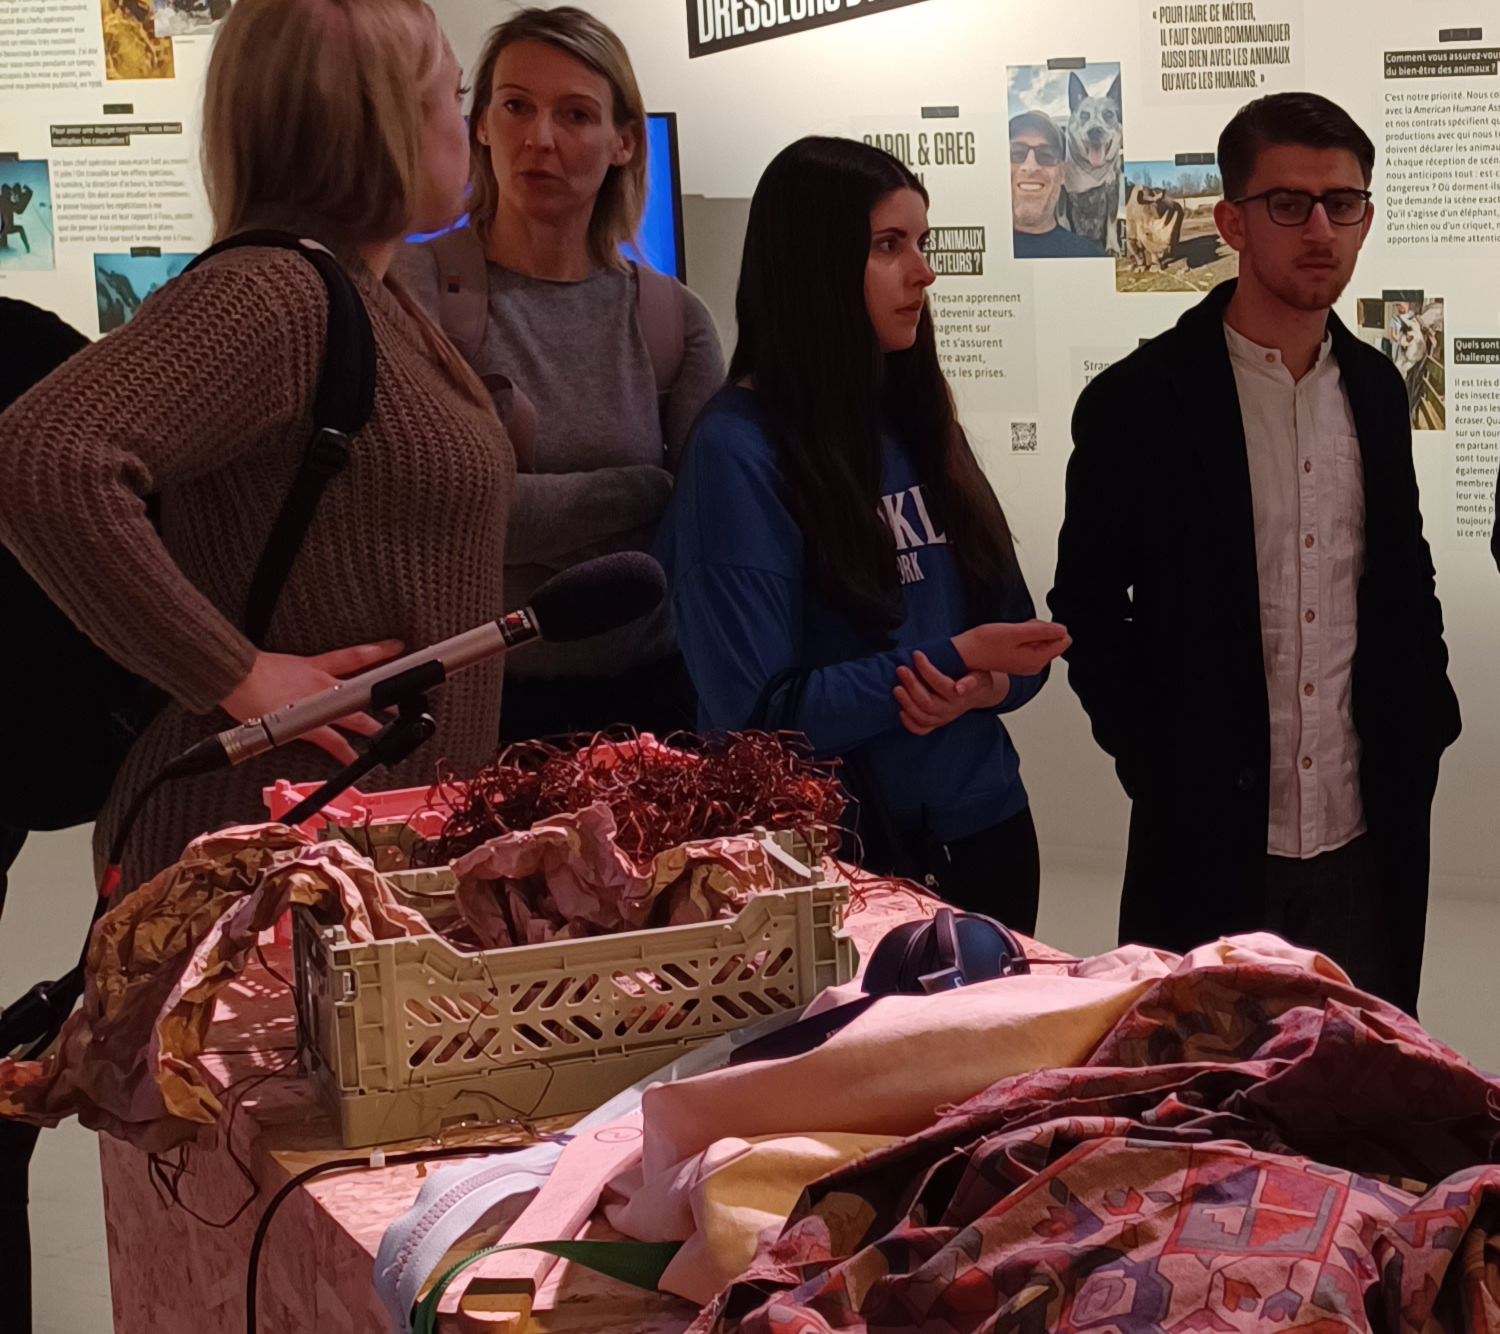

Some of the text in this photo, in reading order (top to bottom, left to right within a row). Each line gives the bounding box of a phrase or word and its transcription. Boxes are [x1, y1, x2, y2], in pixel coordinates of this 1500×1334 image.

[1159, 5, 1183, 24] POUR
[1184, 4, 1207, 23] FAIRE
[1221, 1, 1256, 22] MÉTIER,
[1168, 27, 1189, 46] FAUT
[1191, 26, 1223, 45] SAVOIR
[1224, 24, 1290, 44] COMMUNIQUER
[1161, 46, 1290, 69] AUSSI BIEN AVEC LES ANIMAUX
[1386, 53, 1426, 63] Comment
[1427, 53, 1447, 61] vous
[1398, 66, 1436, 76] bien-être
[1437, 64, 1452, 74] des
[1453, 65, 1490, 73] animaux
[1161, 72, 1197, 91] QU'AVEC
[1198, 71, 1213, 90] LES
[1214, 70, 1258, 89] HUMAINS.
[1384, 93, 1404, 102] C'est
[1406, 93, 1429, 101] notre
[1430, 91, 1465, 102] priorité.
[1466, 90, 1488, 99] Nous
[918, 132, 930, 166] &
[934, 132, 975, 165] GREG
[939, 230, 983, 250] ANIMAUX
[930, 252, 972, 273] ACTEURS
[932, 292, 1021, 304] Tresan apprennent
[939, 308, 975, 318] devenir
[977, 309, 1015, 318] acteurs.
[952, 339, 1003, 348] s'assurent
[1456, 340, 1479, 350] Quels
[1480, 341, 1500, 349] sont
[954, 354, 986, 364] avant,
[1456, 352, 1500, 363] challenges
[958, 367, 1006, 379] les prises.
[1454, 391, 1469, 399] des
